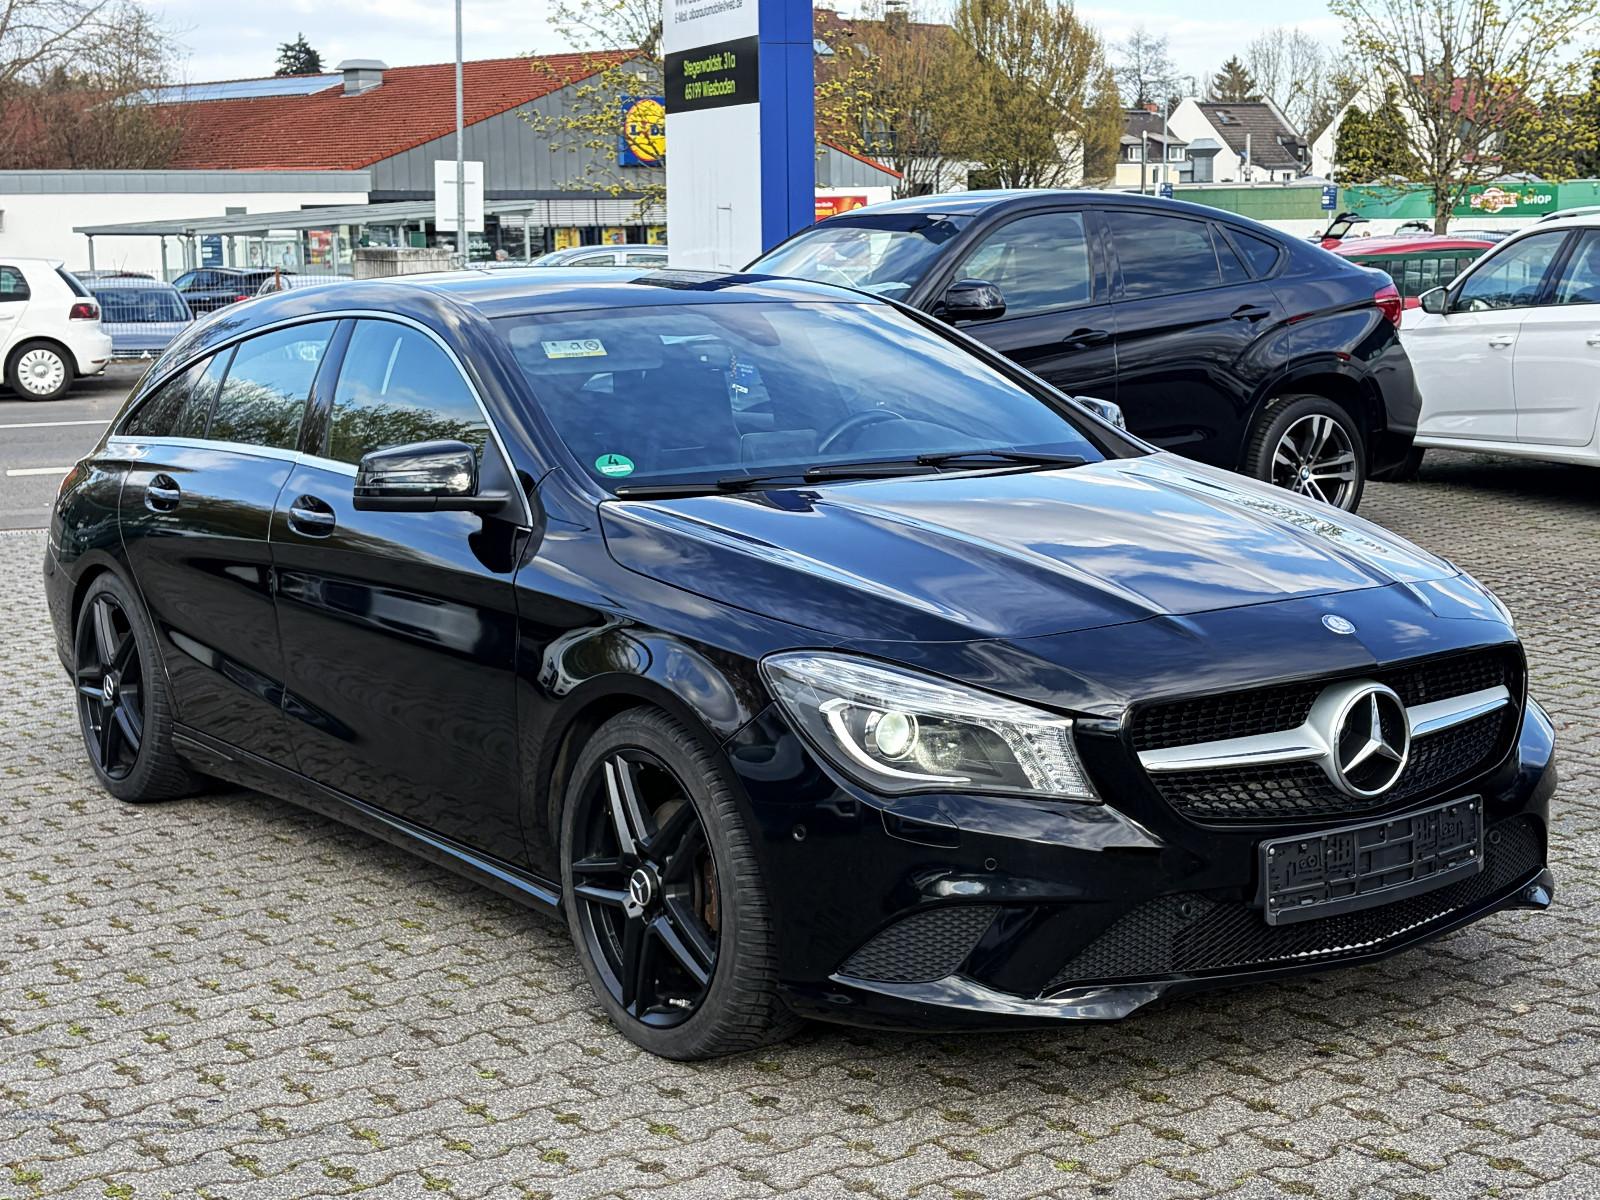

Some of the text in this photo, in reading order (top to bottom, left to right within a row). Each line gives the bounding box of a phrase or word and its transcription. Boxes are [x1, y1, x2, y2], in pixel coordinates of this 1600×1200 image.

[685, 77, 736, 100] 65199 Wiesbaden
[1523, 195, 1552, 205] SHOP
[608, 455, 619, 465] 4
